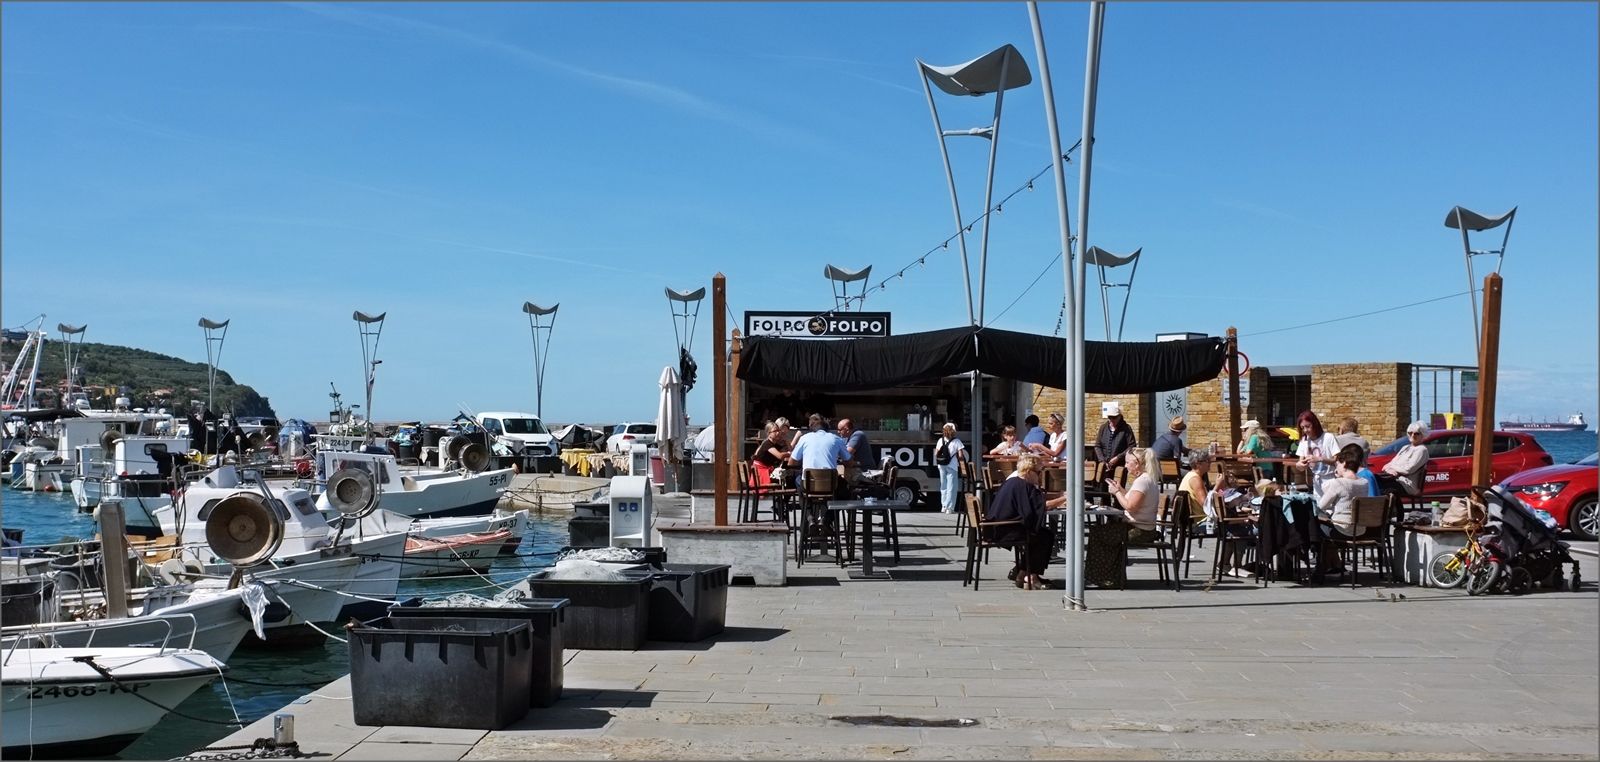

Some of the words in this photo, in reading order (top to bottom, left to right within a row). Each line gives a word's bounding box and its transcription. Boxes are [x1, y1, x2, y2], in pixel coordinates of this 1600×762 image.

[753, 320, 804, 332] FOLPO
[830, 320, 882, 333] FOLPO
[489, 473, 507, 486] 55-PI
[1436, 473, 1450, 481] ABC
[26, 682, 152, 700] 2468-KP
